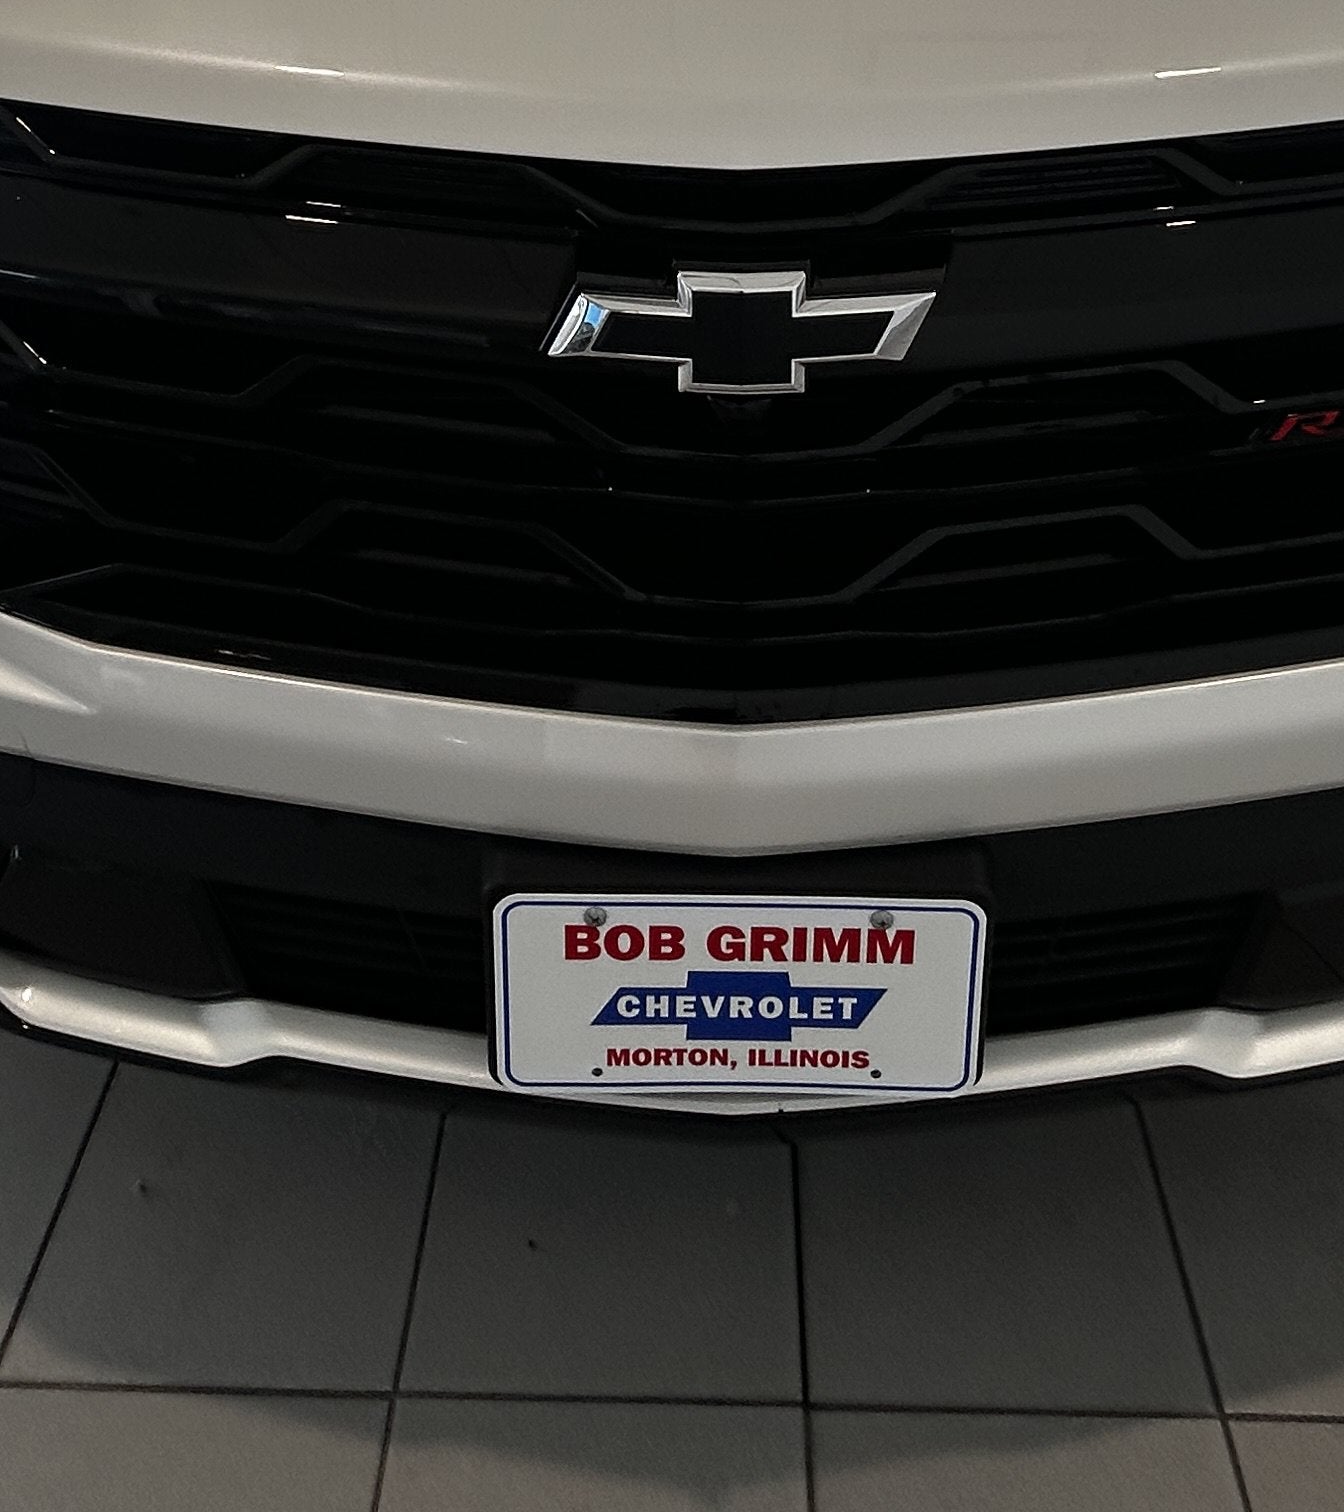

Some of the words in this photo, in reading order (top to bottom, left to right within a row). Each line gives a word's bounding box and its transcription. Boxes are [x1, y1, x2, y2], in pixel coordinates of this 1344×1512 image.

[563, 924, 686, 961] BOB
[705, 926, 915, 965] GRIMM
[616, 994, 859, 1020] CHEVROLET
[606, 1047, 738, 1071] MORTON,
[747, 1049, 870, 1070] ILLINOIS
